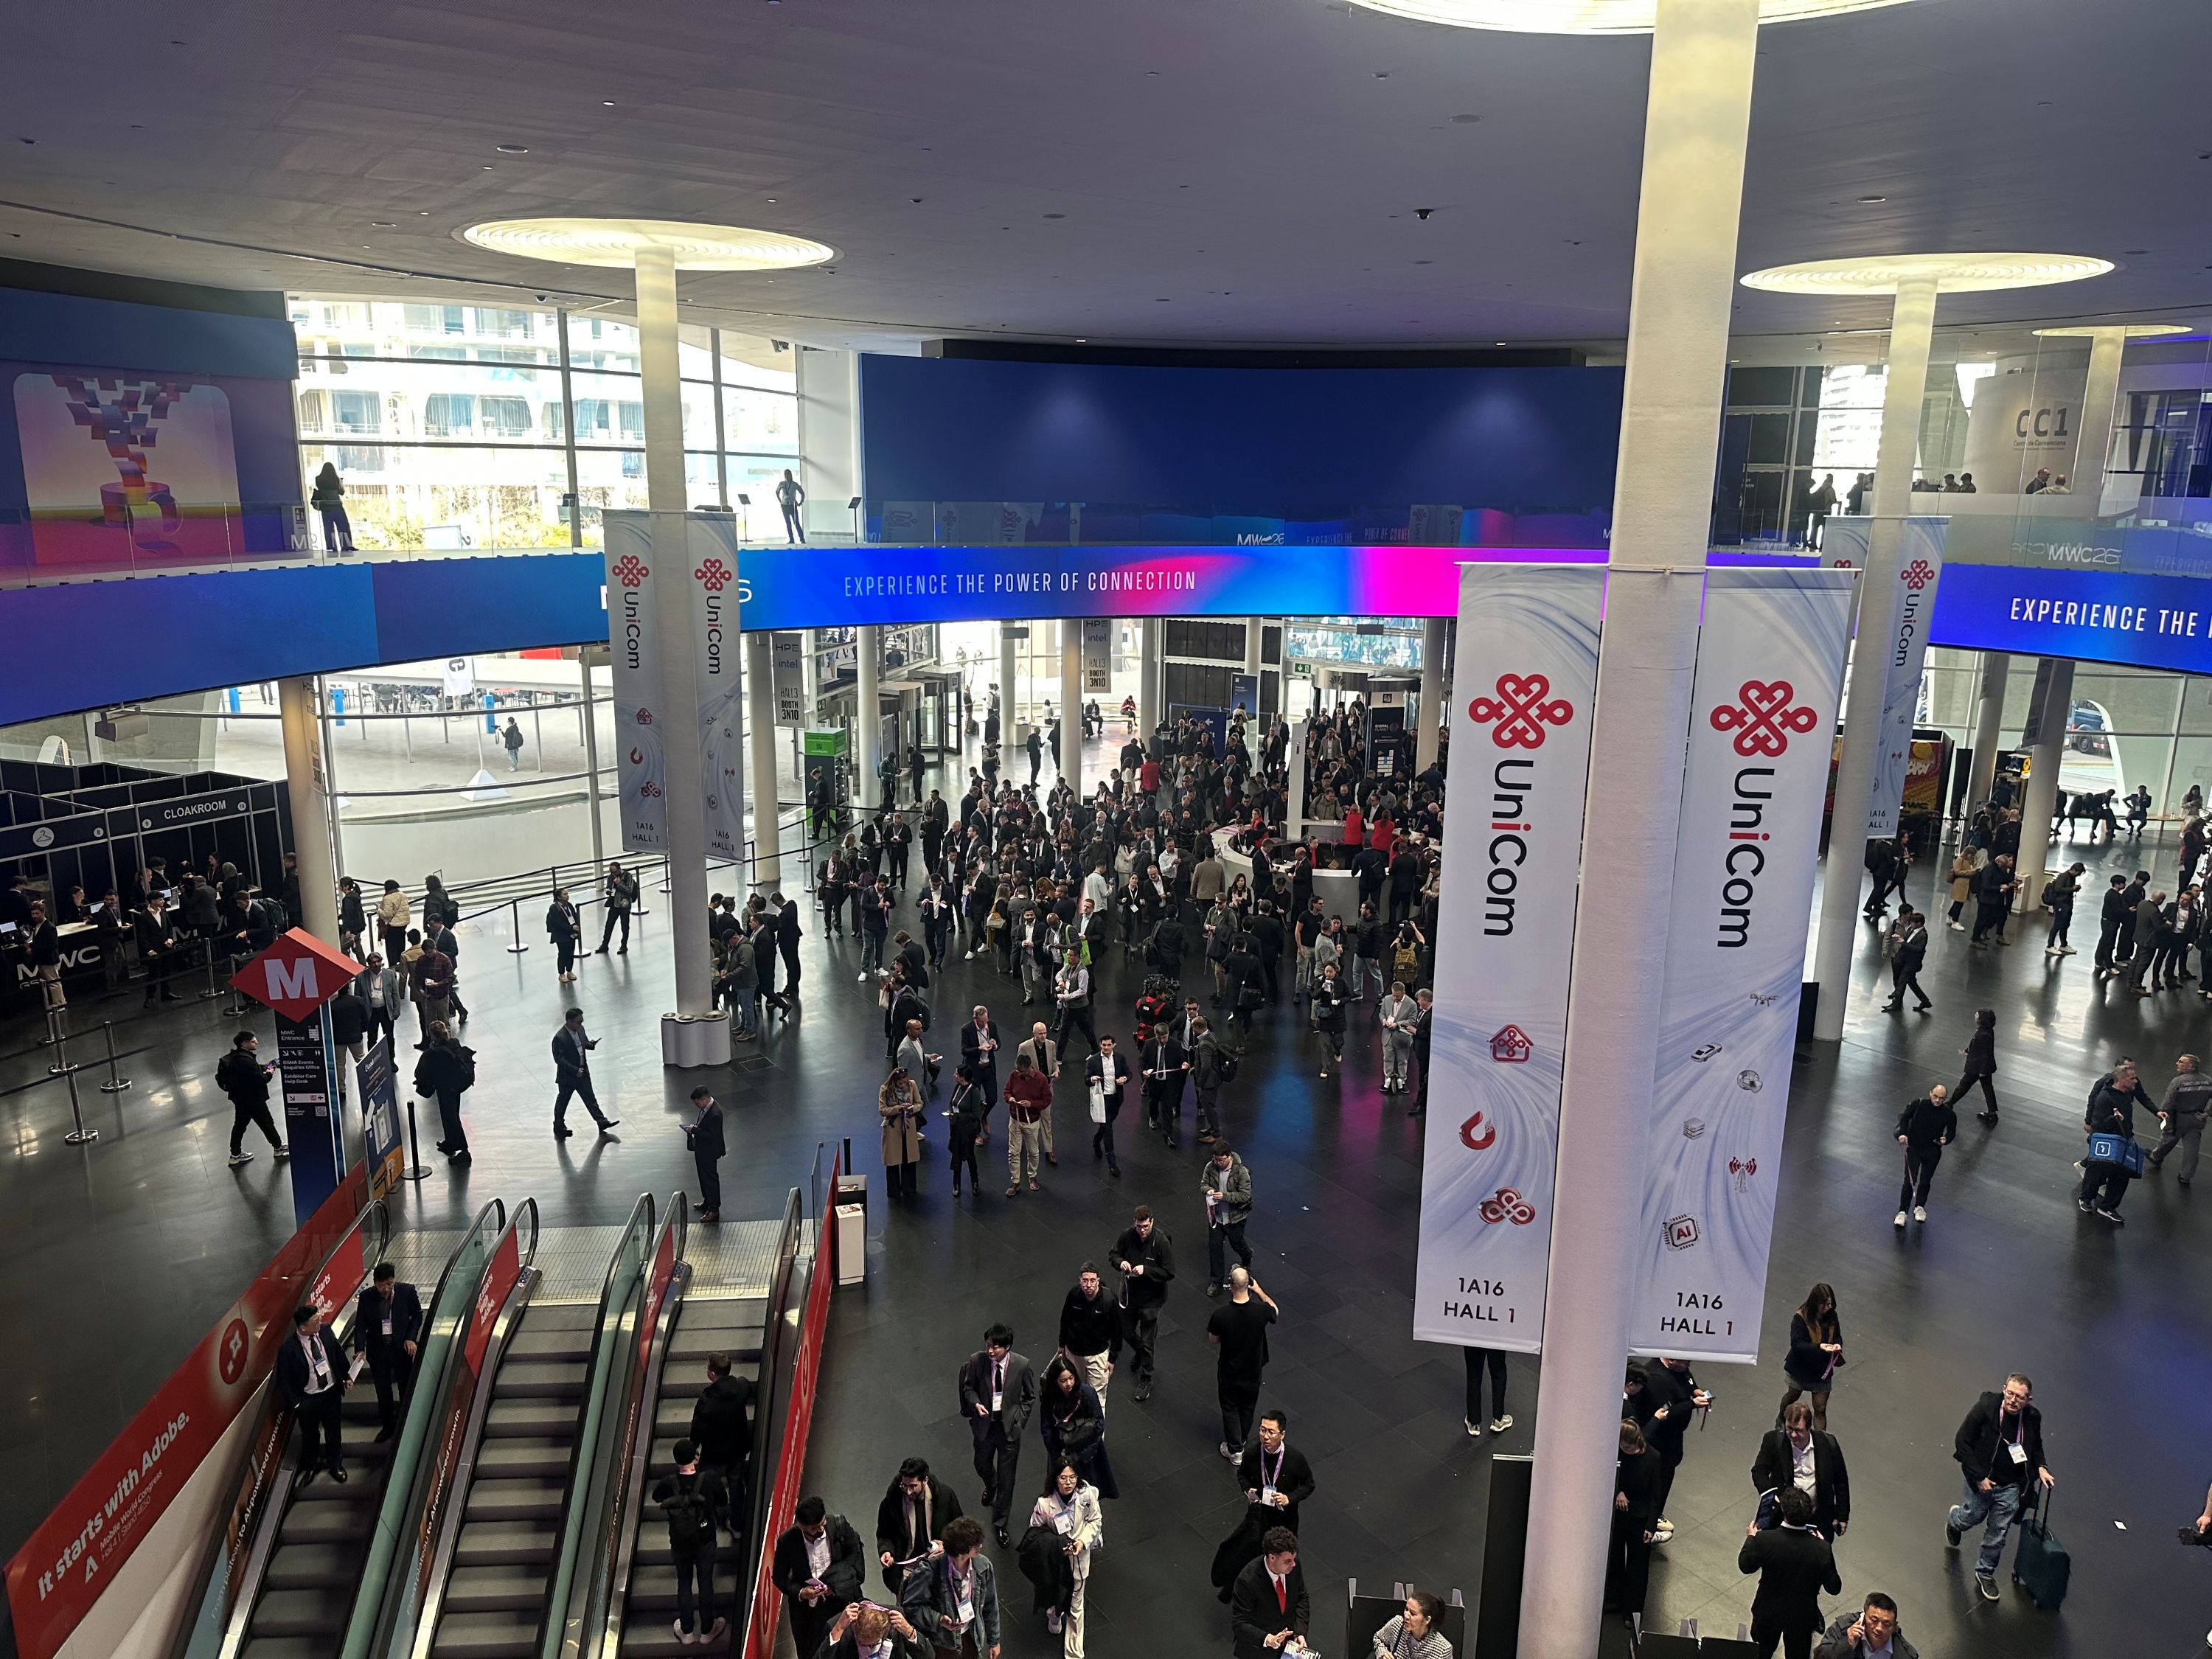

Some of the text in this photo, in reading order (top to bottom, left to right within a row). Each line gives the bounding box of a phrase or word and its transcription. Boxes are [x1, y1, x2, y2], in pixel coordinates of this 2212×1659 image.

[2016, 407, 2067, 437] CC1
[844, 571, 1195, 597] EXPERIENCE THE POWER OF CONNECTION
[2010, 597, 2199, 637] EXPERIENCE THE
[624, 591, 641, 669] UniCom
[706, 596, 723, 675] UniCom
[1088, 633, 1107, 642] intel
[1895, 594, 1920, 667] UniCom
[776, 644, 799, 653] HPE
[779, 659, 798, 669] intel
[1089, 678, 1106, 687] 3N10
[781, 700, 799, 709] BOOTH
[782, 709, 799, 720] 3N10
[164, 799, 226, 820] CLOAKROOM
[636, 821, 654, 831] 1A16
[715, 830, 730, 839] 1A16
[632, 833, 653, 843] HALL
[712, 841, 729, 851] HALL
[1484, 759, 1534, 936] UniCom
[1717, 768, 1775, 947] UniCom
[263, 957, 319, 1000] M
[1677, 1225, 1691, 1240] AI
[310, 1273, 331, 1303] It starts
[1458, 1277, 1504, 1296] 1A16
[1444, 1301, 1514, 1323] HALL 1
[1677, 1292, 1723, 1310] 1A16
[1660, 1317, 1733, 1336] HALL 1
[38, 1411, 190, 1601] It starts with Adobe.
[414, 1537, 429, 1585] plateau
[427, 1520, 433, 1535] to
[431, 1447, 451, 1521] AI-powered
[448, 1408, 462, 1449] growth.
[100, 1469, 164, 1552] Mobile World Congress
[210, 1410, 285, 1620] From plateau to AI-powered growth.
[121, 1513, 139, 1537] Stand
